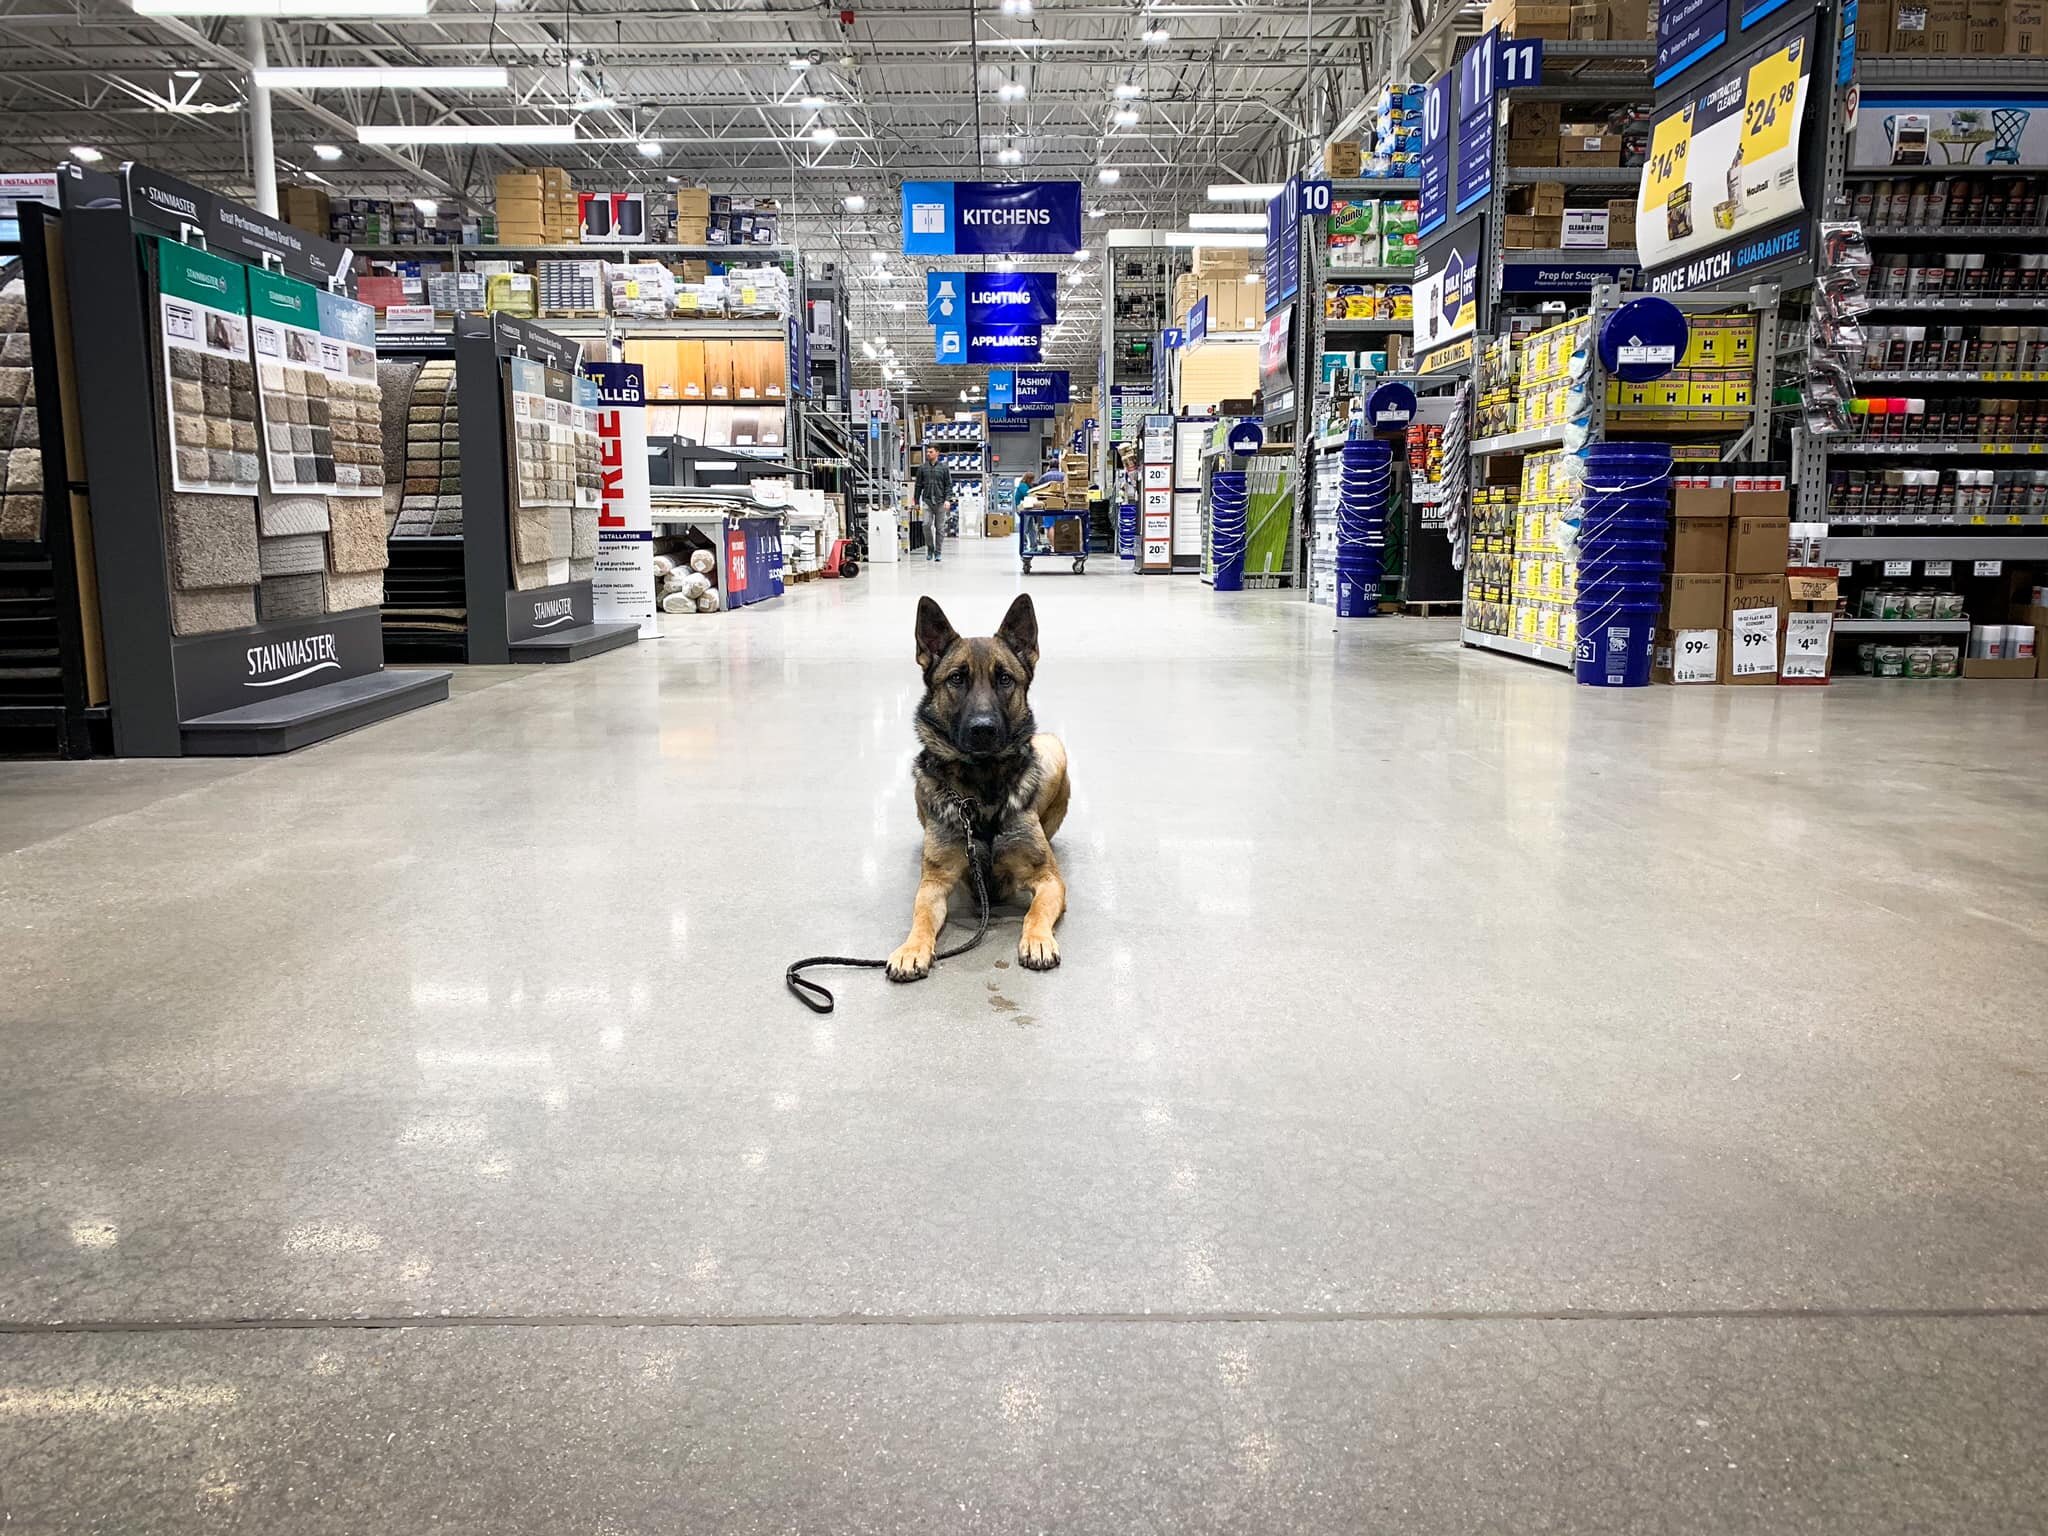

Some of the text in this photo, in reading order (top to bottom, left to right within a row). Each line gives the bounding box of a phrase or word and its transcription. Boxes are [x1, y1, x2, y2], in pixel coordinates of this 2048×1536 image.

[1503, 46, 1534, 81] 11
[1707, 76, 1741, 106] CONTRACTOR
[1717, 89, 1742, 112] CLEANUP
[149, 187, 197, 217] STAINMASTER
[1303, 185, 1329, 210] 10
[963, 209, 1050, 225] KITCHENS
[1335, 208, 1363, 230] Bounty
[1652, 229, 1801, 293] PRICE MATCH GUARANTEE
[1445, 273, 1460, 295] BULK
[1538, 271, 1560, 281] Prep
[1561, 271, 1574, 280] for
[971, 291, 1031, 305] LIGHTING
[971, 336, 1038, 347] APPLIANCES
[1168, 331, 1178, 344] 7
[1017, 378, 1051, 386] FASHION
[1017, 387, 1038, 395] BATH
[1087, 420, 1093, 428] 2
[534, 597, 574, 621] STAINMASTER
[246, 634, 336, 676] STAINMASTER
